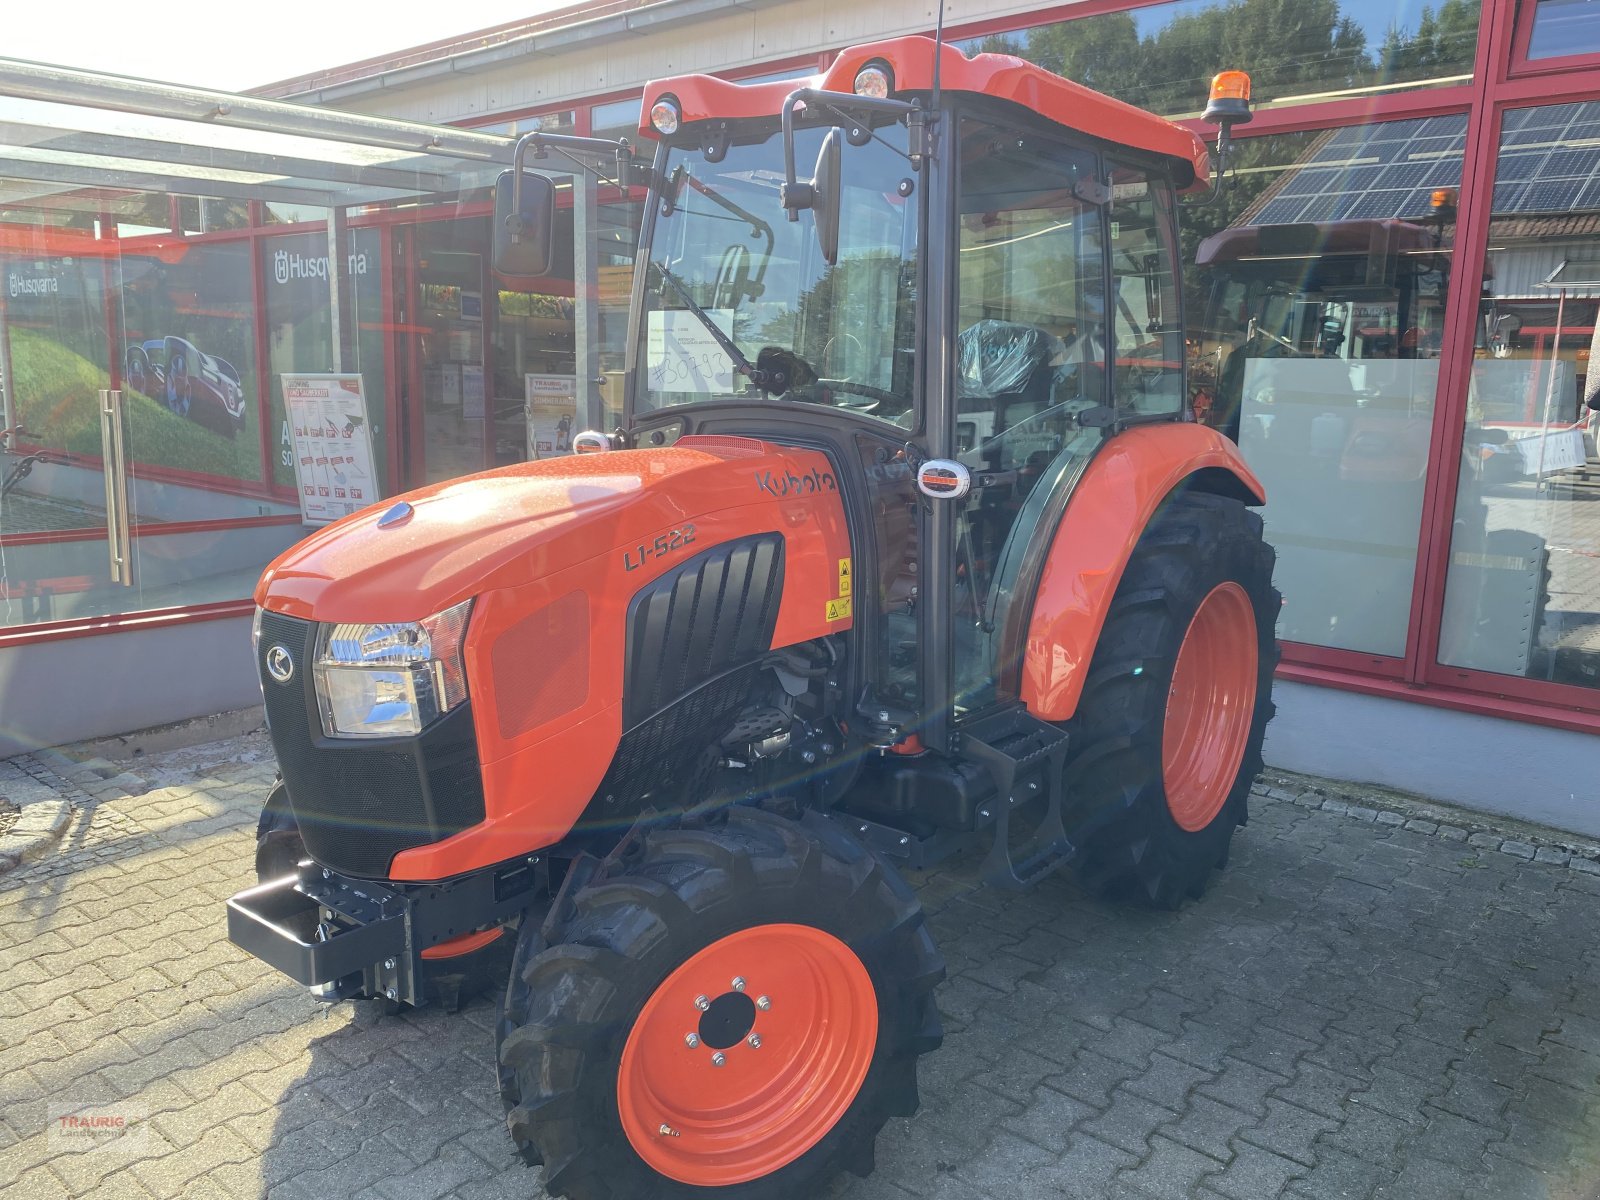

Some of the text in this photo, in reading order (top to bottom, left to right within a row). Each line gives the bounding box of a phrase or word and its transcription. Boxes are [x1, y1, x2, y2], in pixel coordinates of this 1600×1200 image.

[289, 253, 367, 280] Husqvna
[17, 275, 58, 297] Husqvarna
[652, 352, 726, 385] #30793
[754, 467, 836, 496] Kubota
[623, 523, 697, 572] L1-522
